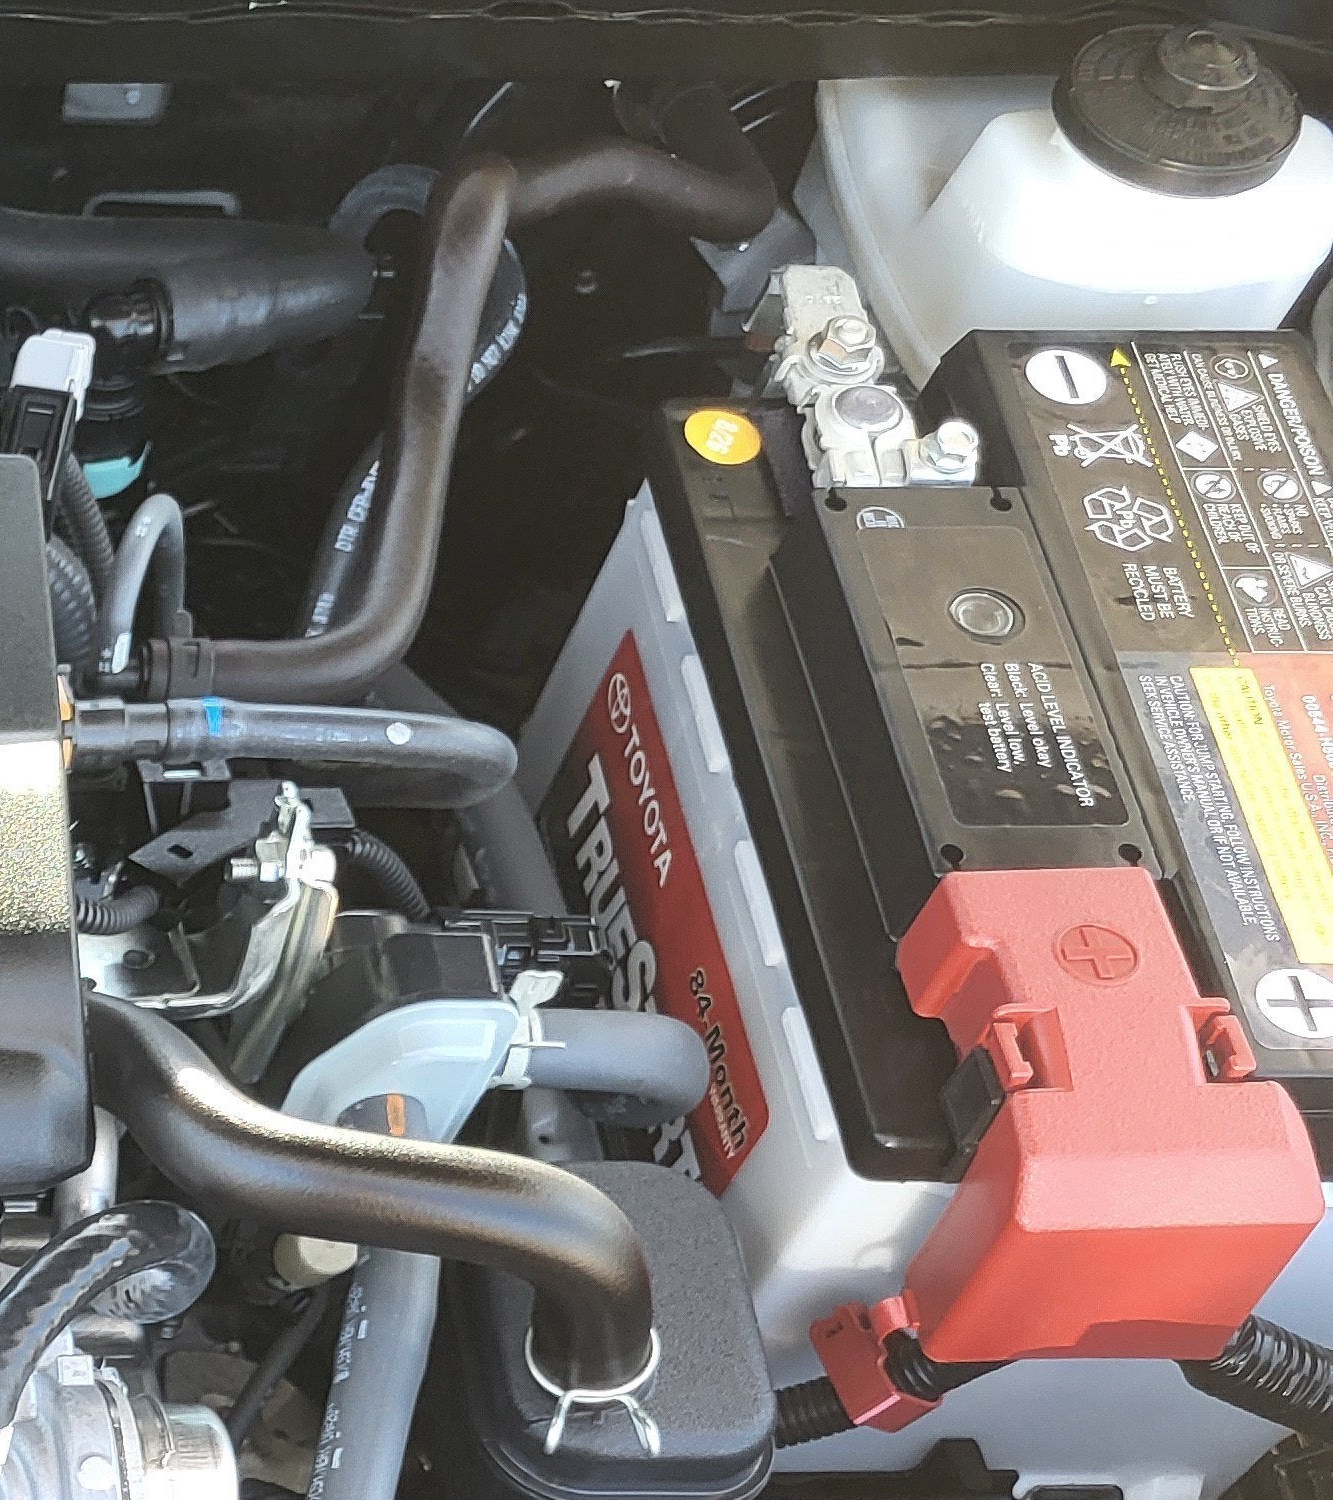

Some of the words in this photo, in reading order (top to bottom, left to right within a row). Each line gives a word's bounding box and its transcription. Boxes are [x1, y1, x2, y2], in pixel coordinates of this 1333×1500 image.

[1266, 373, 1325, 475] DANGER/POISON
[1046, 434, 1075, 457] Pb
[1114, 510, 1138, 528] Pb
[1292, 504, 1310, 516] NO
[1118, 563, 1158, 621] RECYCLED
[1140, 565, 1168, 600] MUST
[1154, 602, 1175, 618] BE
[1160, 567, 1195, 617] BATTERY
[1002, 662, 1030, 698] Black:
[1026, 662, 1052, 692] ACID
[1136, 675, 1158, 699] SEEK
[1153, 675, 1169, 686] IN
[975, 702, 997, 725] test
[978, 662, 1005, 698] Clear:
[993, 702, 1019, 735] Level
[1006, 738, 1030, 764] low,
[1038, 694, 1067, 733] LEVEL
[1157, 687, 1184, 726] VEHICLE
[1167, 675, 1197, 720] CAUTION:
[1258, 685, 1286, 716] Toyota
[1017, 702, 1044, 735] Level
[1146, 700, 1173, 739] SERVICE
[1184, 722, 1204, 740] FOR
[1272, 719, 1299, 749] Motor
[984, 728, 1014, 772] battery
[1030, 737, 1056, 767] okay
[1172, 728, 1201, 772] OWNER'S
[1192, 741, 1215, 770] JUMP
[1285, 752, 1311, 779] Sales
[1053, 735, 1095, 807] INDICATOR
[623, 725, 674, 888] TOYOTA
[1189, 774, 1218, 817] MANUAL
[1203, 772, 1235, 822] STARTING,
[1205, 819, 1223, 833] OR
[1215, 844, 1236, 867] NOT
[1223, 824, 1252, 866] FOLLOW
[1239, 866, 1280, 940] INSTRUCTIONS
